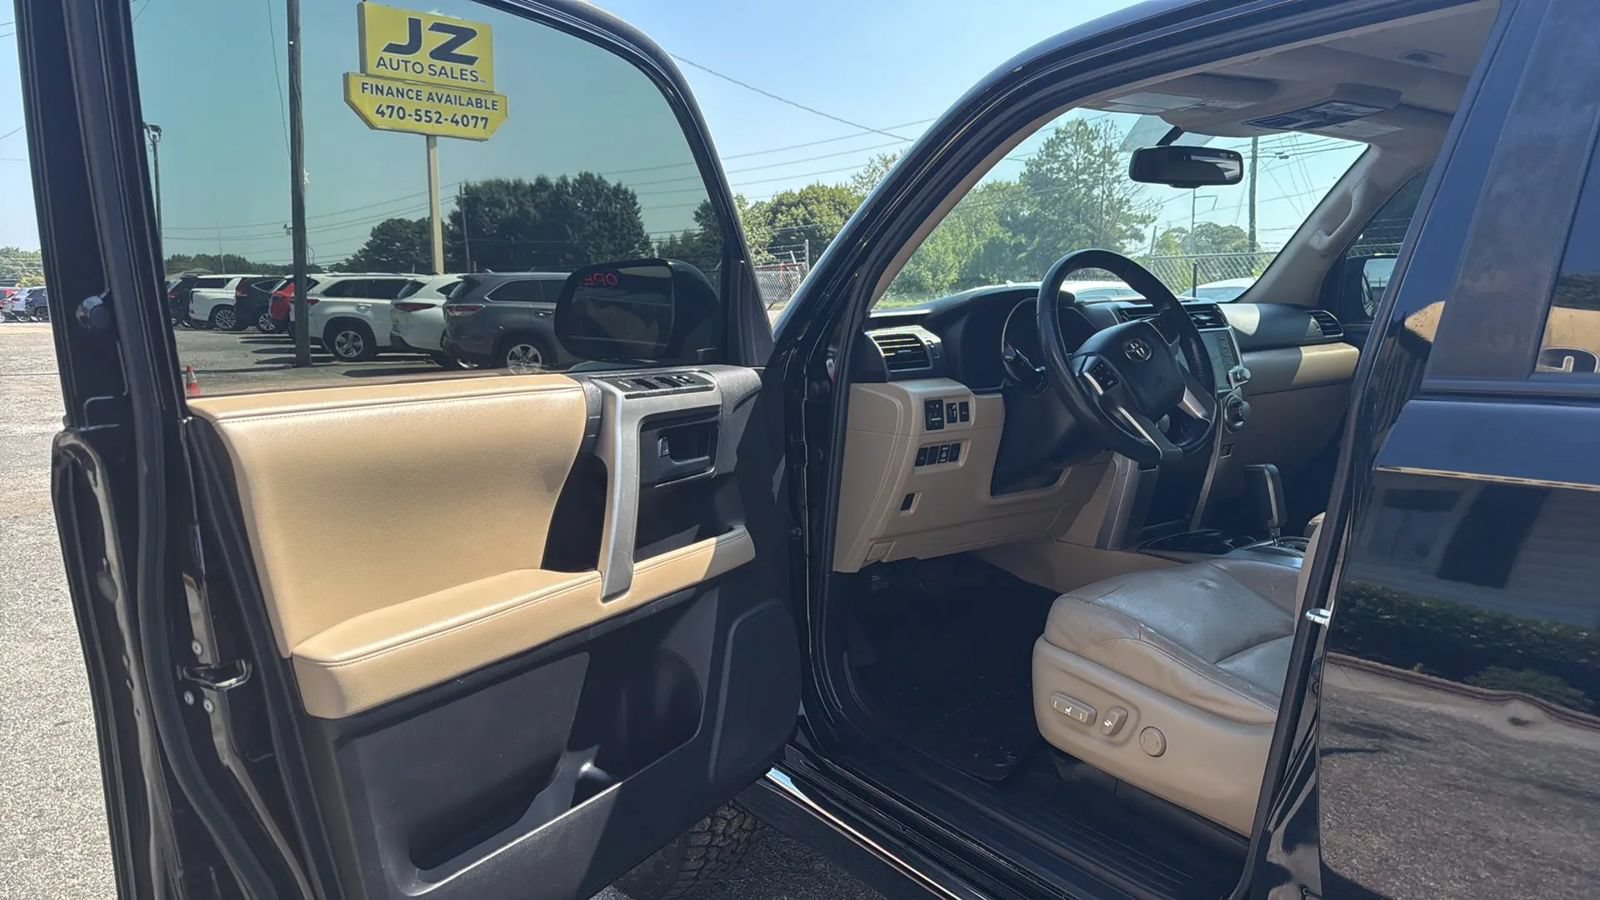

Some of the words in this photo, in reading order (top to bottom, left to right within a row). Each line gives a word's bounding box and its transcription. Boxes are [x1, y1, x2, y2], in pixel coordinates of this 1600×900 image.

[382, 17, 479, 66] JZ
[376, 56, 424, 75] AUTO
[428, 64, 479, 82] SALES
[361, 82, 423, 101] FINANCE
[426, 92, 499, 111] AVAILABLE
[375, 104, 489, 130] 470-552-4077
